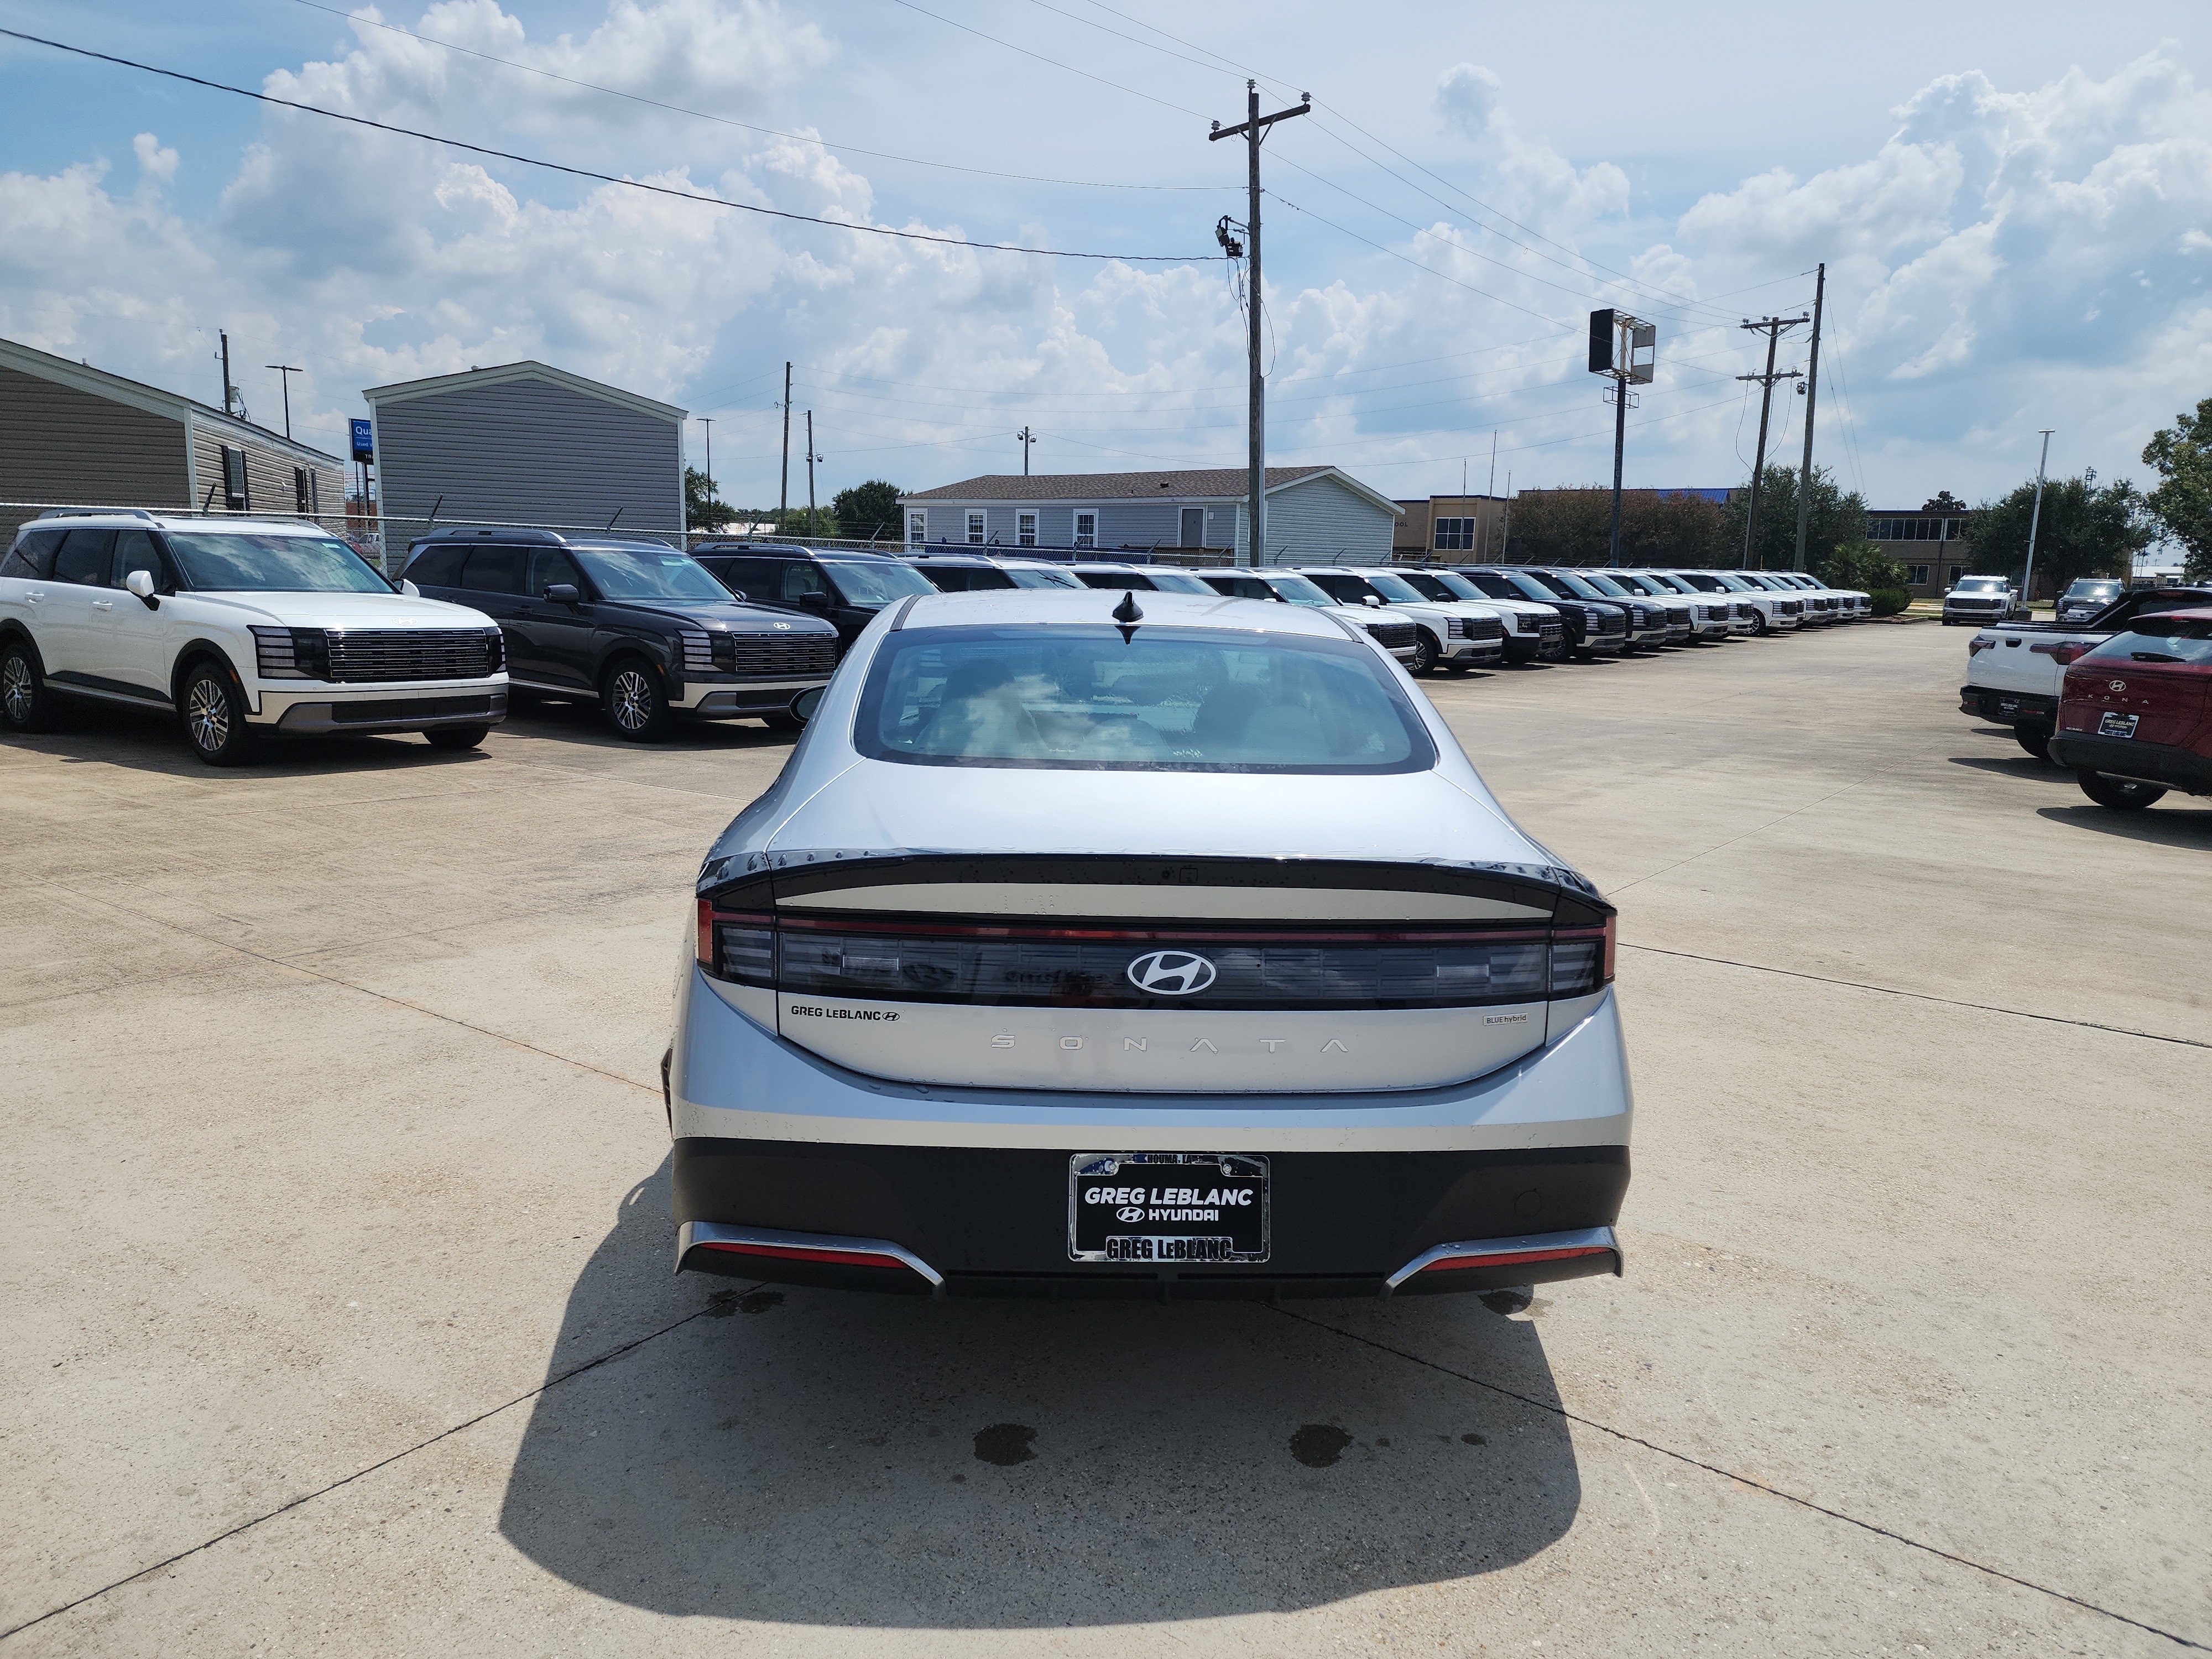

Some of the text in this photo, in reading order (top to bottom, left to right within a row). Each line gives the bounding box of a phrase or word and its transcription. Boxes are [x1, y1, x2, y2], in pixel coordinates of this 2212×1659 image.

[2088, 694, 2149, 705] KONA
[791, 1005, 822, 1017] GREG
[1504, 1014, 1526, 1022] hybrid
[991, 1034, 1348, 1053] SONATA
[1182, 1154, 1192, 1164] LA
[1085, 1187, 1253, 1206] GREG LEBLANC
[1149, 1209, 1219, 1221] HYUNDAI
[1107, 1239, 1153, 1260] GREG
